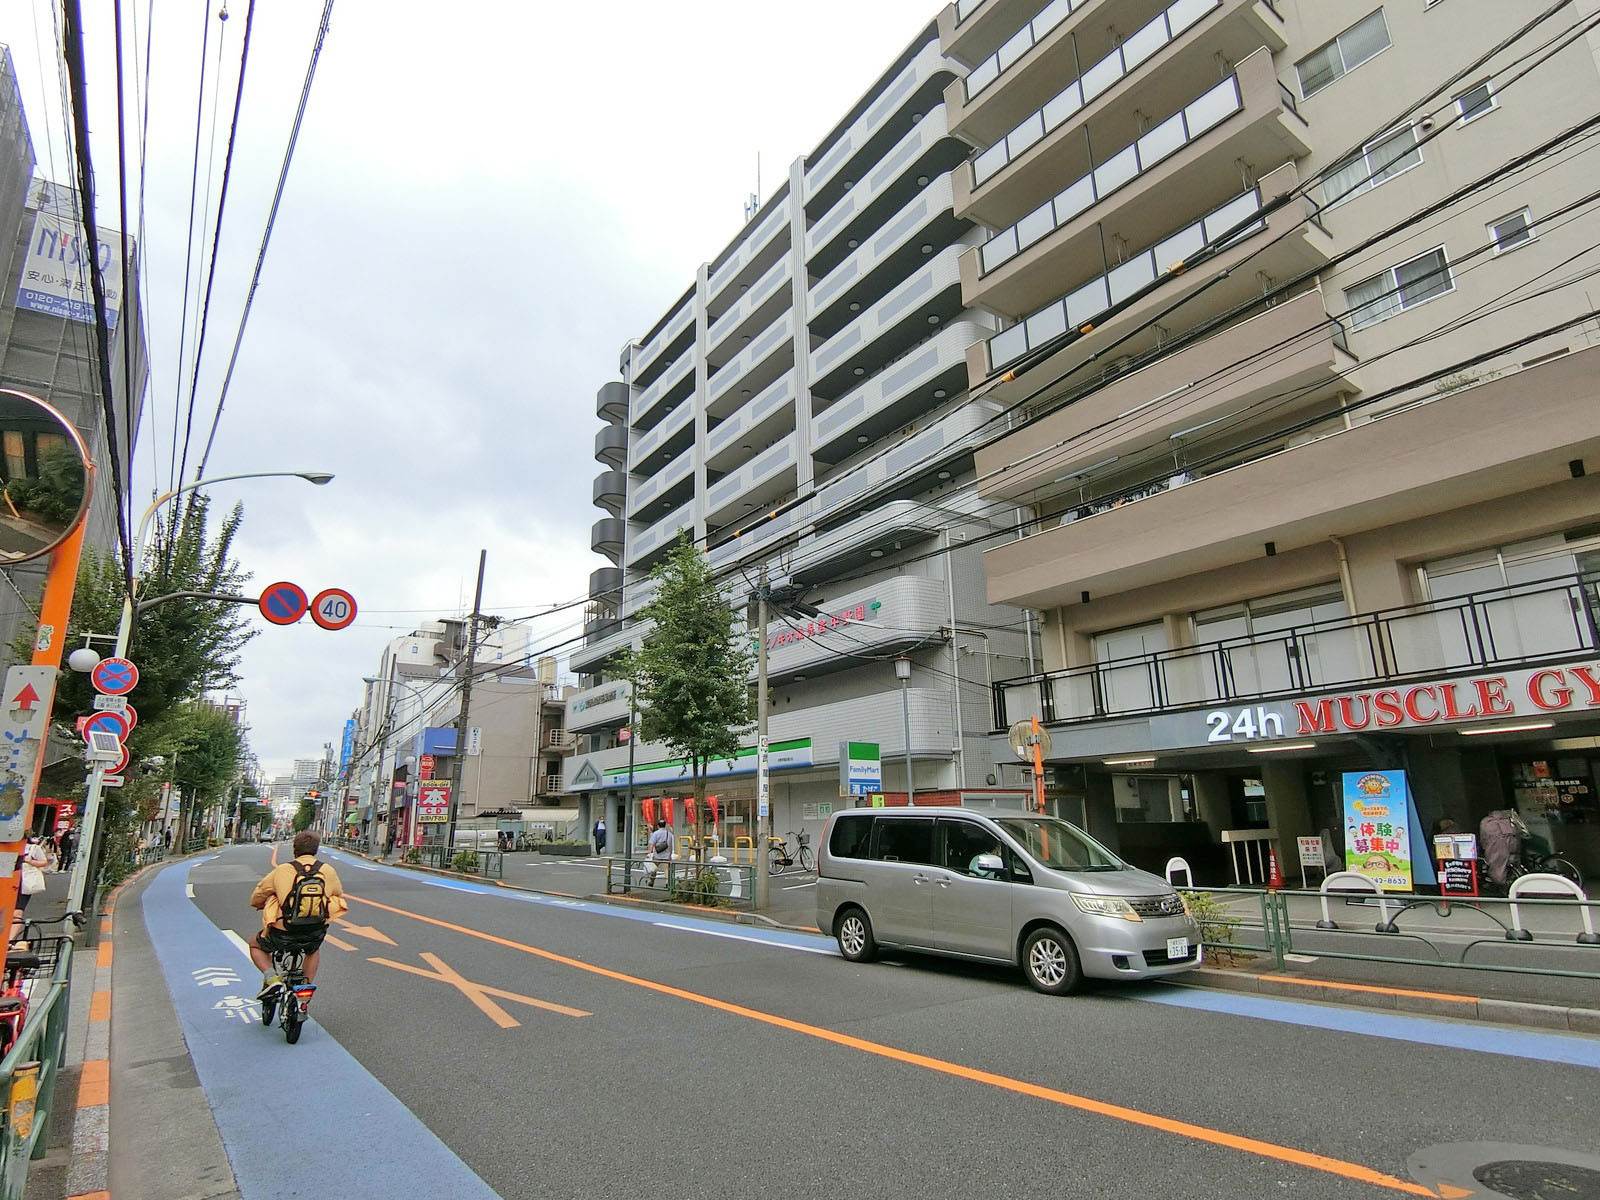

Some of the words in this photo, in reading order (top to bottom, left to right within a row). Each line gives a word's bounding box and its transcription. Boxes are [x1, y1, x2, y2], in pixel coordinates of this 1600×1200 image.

[322, 601, 347, 619] 40
[1206, 705, 1285, 743] 24h
[1296, 676, 1515, 735] MUSCLE
[849, 765, 880, 775] FamilyMart
[422, 789, 447, 806] 本
[862, 785, 879, 794] たばこ
[1360, 822, 1392, 837] 体験
[1354, 837, 1399, 853] 募集中
